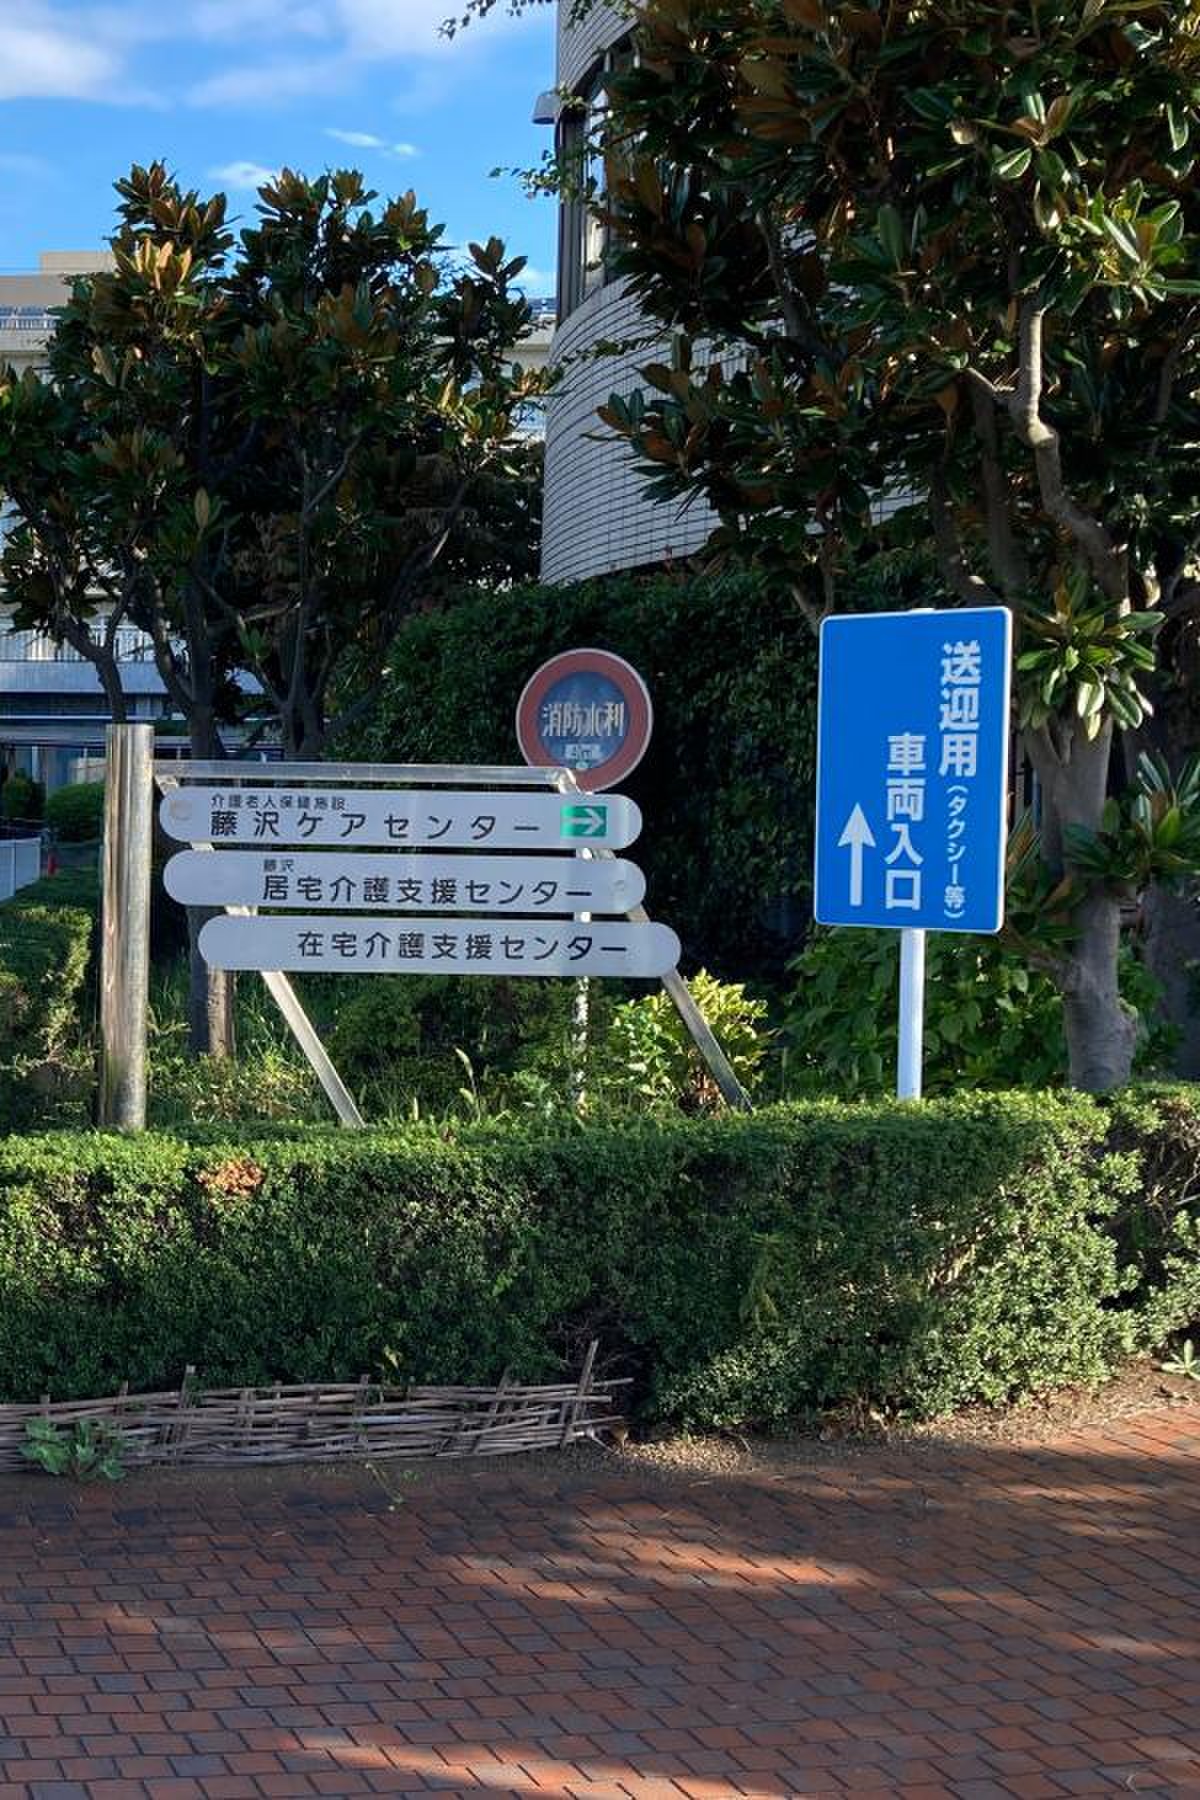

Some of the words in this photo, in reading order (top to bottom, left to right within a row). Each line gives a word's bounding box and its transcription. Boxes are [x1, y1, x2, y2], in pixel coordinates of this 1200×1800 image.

[541, 702, 625, 737] 消防水利
[211, 794, 346, 811] 介護老人保健施設
[211, 809, 540, 840] 藤沢ケアセンター
[884, 732, 927, 912] 車両入口
[263, 858, 295, 873] 藤沢
[262, 875, 593, 905] 居宅介護支援センター
[297, 930, 628, 961] 在宅介護支援センター
